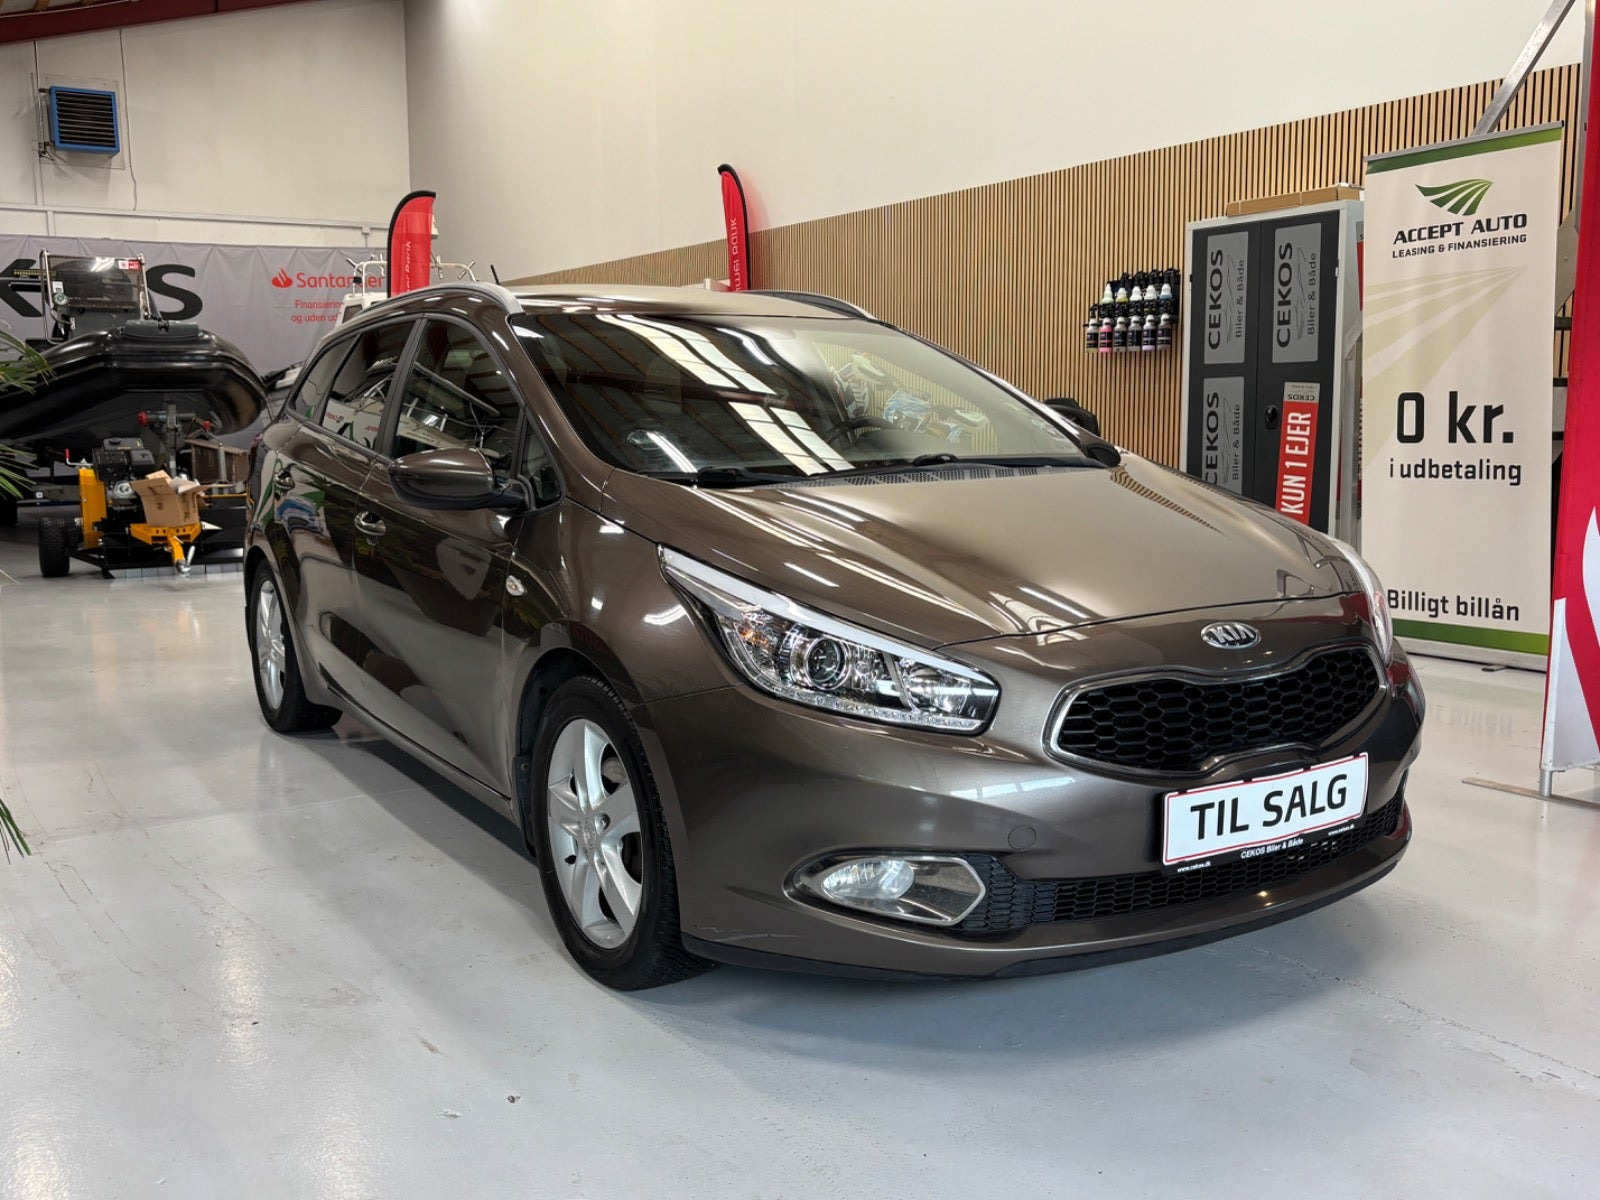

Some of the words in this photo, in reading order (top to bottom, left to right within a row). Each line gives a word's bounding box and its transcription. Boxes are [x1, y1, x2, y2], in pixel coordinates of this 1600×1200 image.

[1393, 222, 1464, 245] ACCEPT
[1471, 214, 1527, 234] AUTO
[1392, 245, 1435, 259] LEASING
[1438, 244, 1445, 253] &
[1448, 234, 1527, 252] FINANSIERING
[1308, 253, 1317, 286] Både
[1208, 249, 1223, 350] CEKOS
[1276, 242, 1293, 348] CEKOS
[1308, 291, 1316, 301] &
[291, 314, 302, 324] og
[1235, 309, 1243, 338] Biler
[1307, 306, 1315, 335] Biler
[1397, 392, 1425, 443] 0
[1448, 391, 1514, 443] kr.
[1233, 440, 1240, 448] &
[1285, 411, 1311, 455] EJER
[1232, 453, 1240, 480] Biler
[1390, 458, 1394, 478] i
[1400, 458, 1522, 486] udbetaling
[1281, 474, 1306, 514] KUN
[1387, 589, 1449, 618] Billigt
[1456, 595, 1519, 621] billån
[1209, 623, 1255, 643] KIA
[1190, 797, 1249, 840] TIL
[1262, 774, 1347, 827] SALG
[1240, 846, 1266, 859] CEKOS
